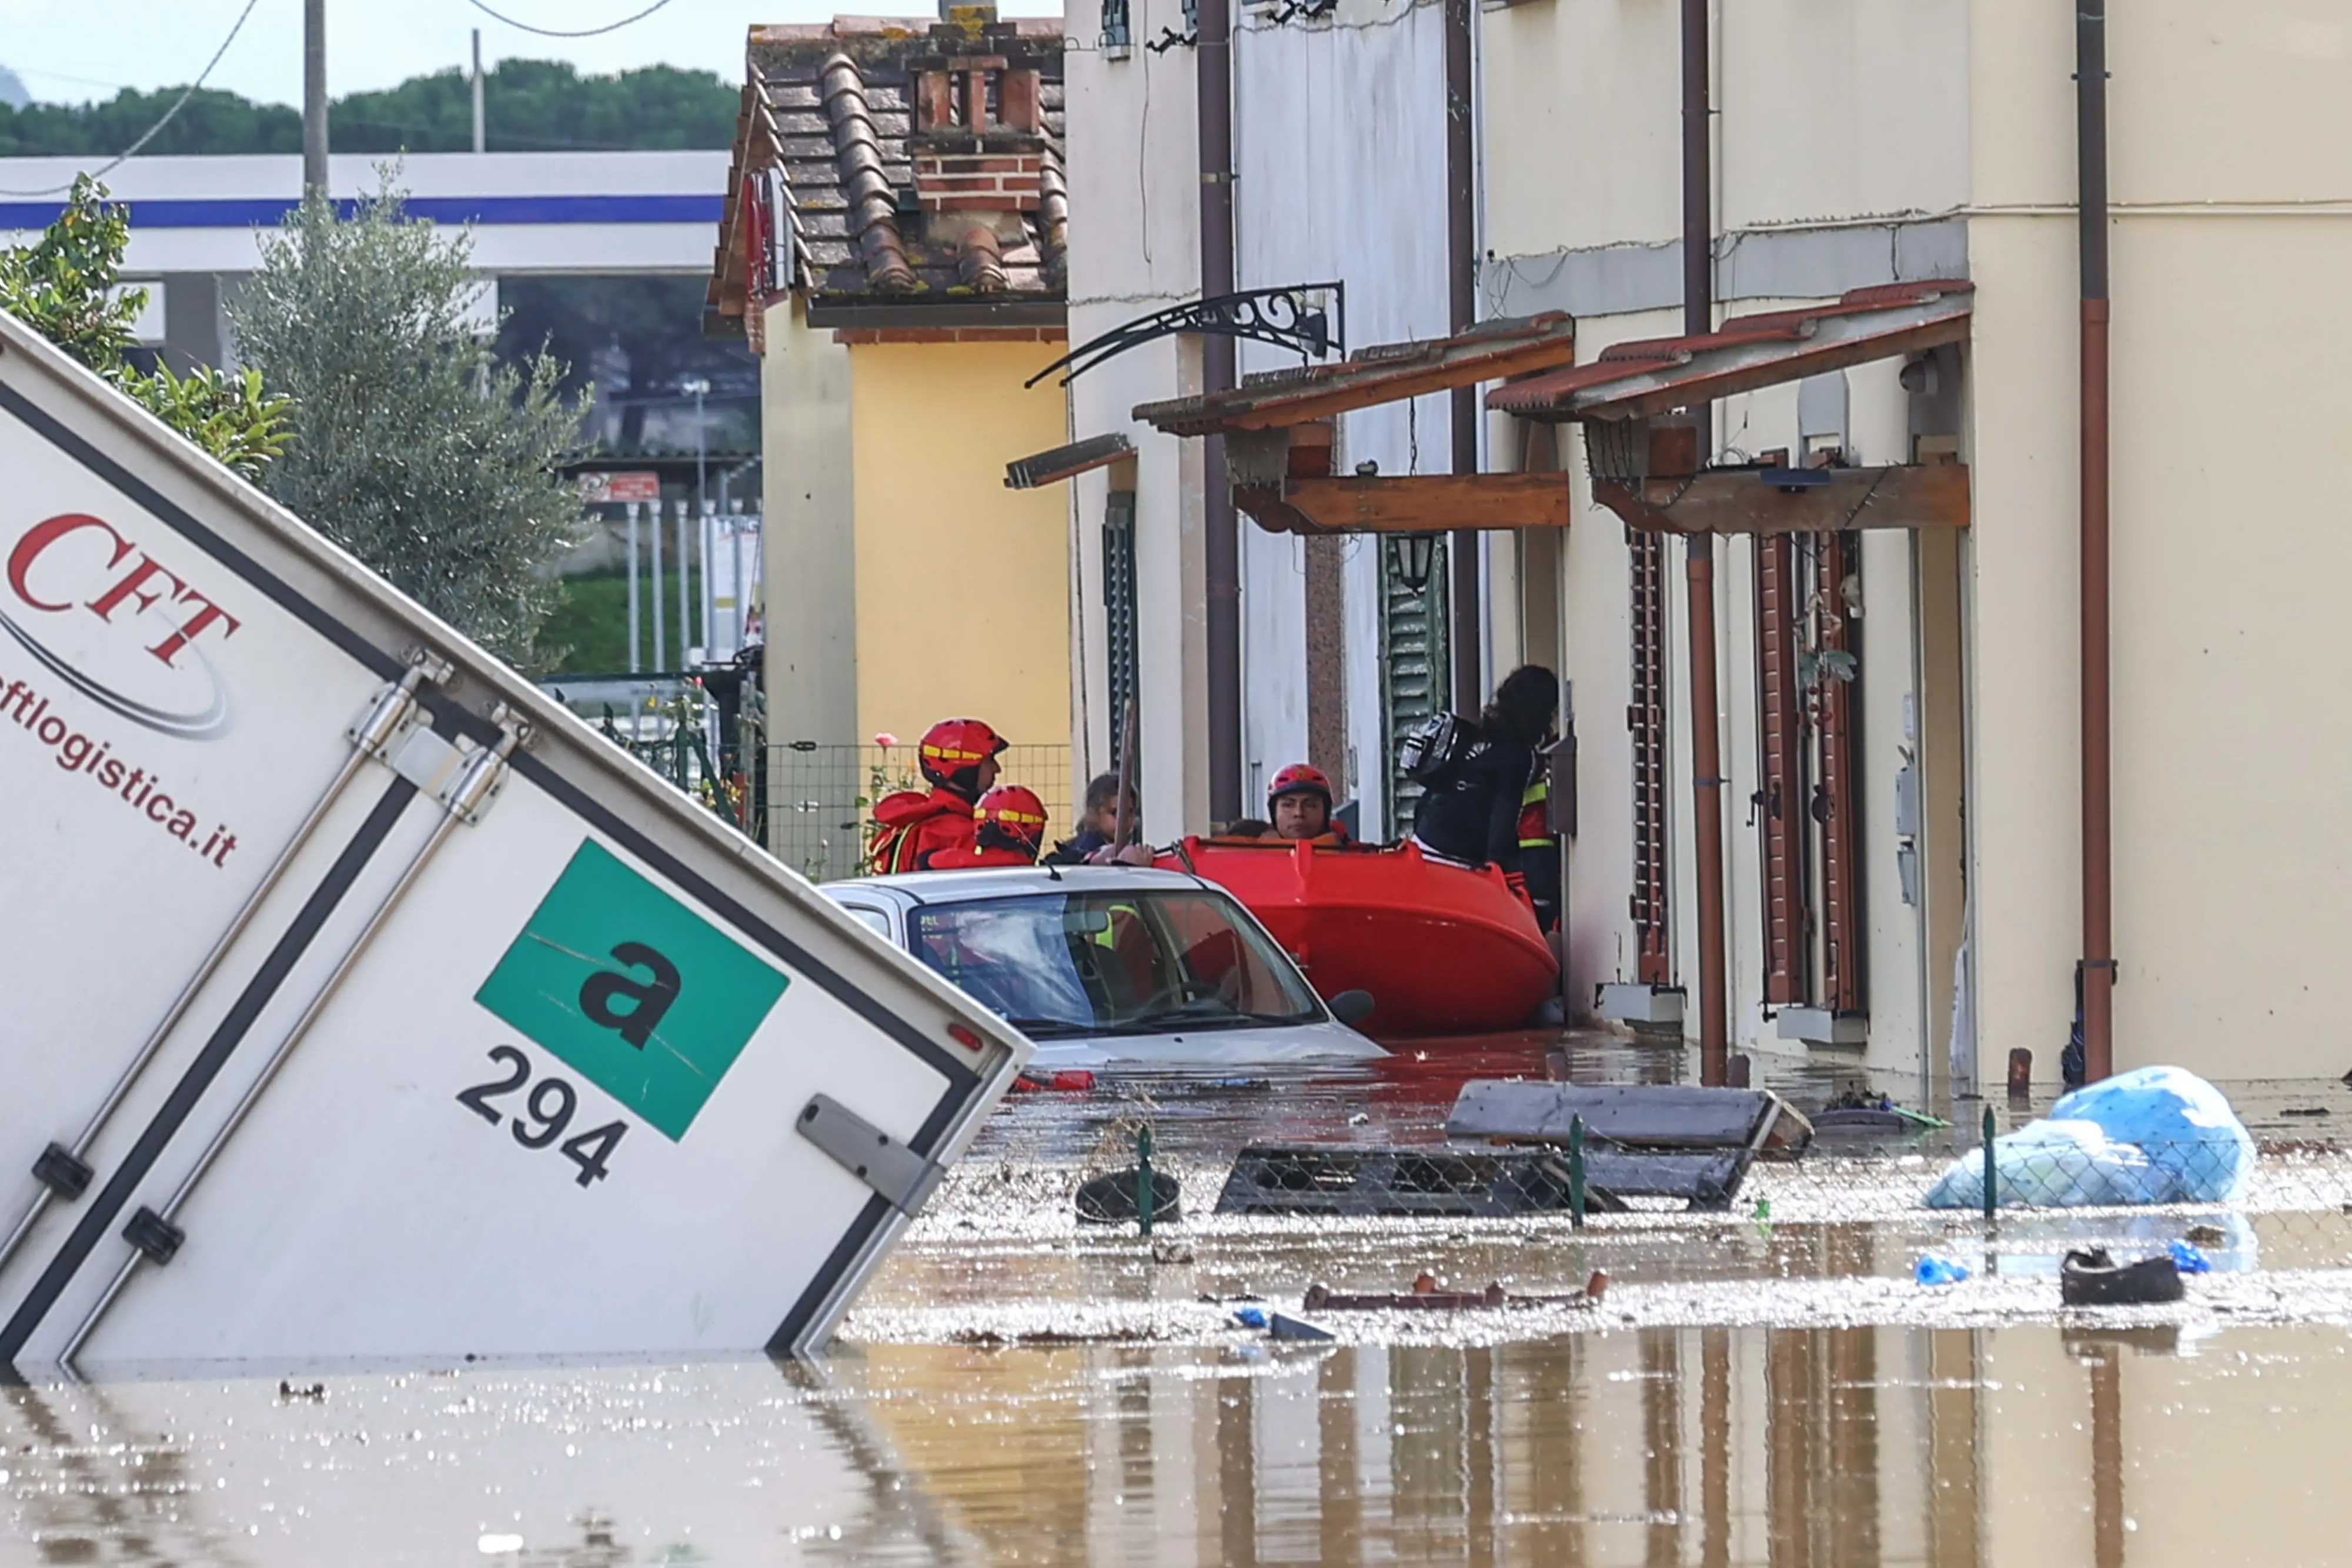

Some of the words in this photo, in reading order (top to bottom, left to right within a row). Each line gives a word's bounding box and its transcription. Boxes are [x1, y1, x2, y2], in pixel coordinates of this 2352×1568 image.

[7, 513, 241, 668] CFT
[579, 941, 681, 1051] a
[456, 1045, 629, 1189] 294
